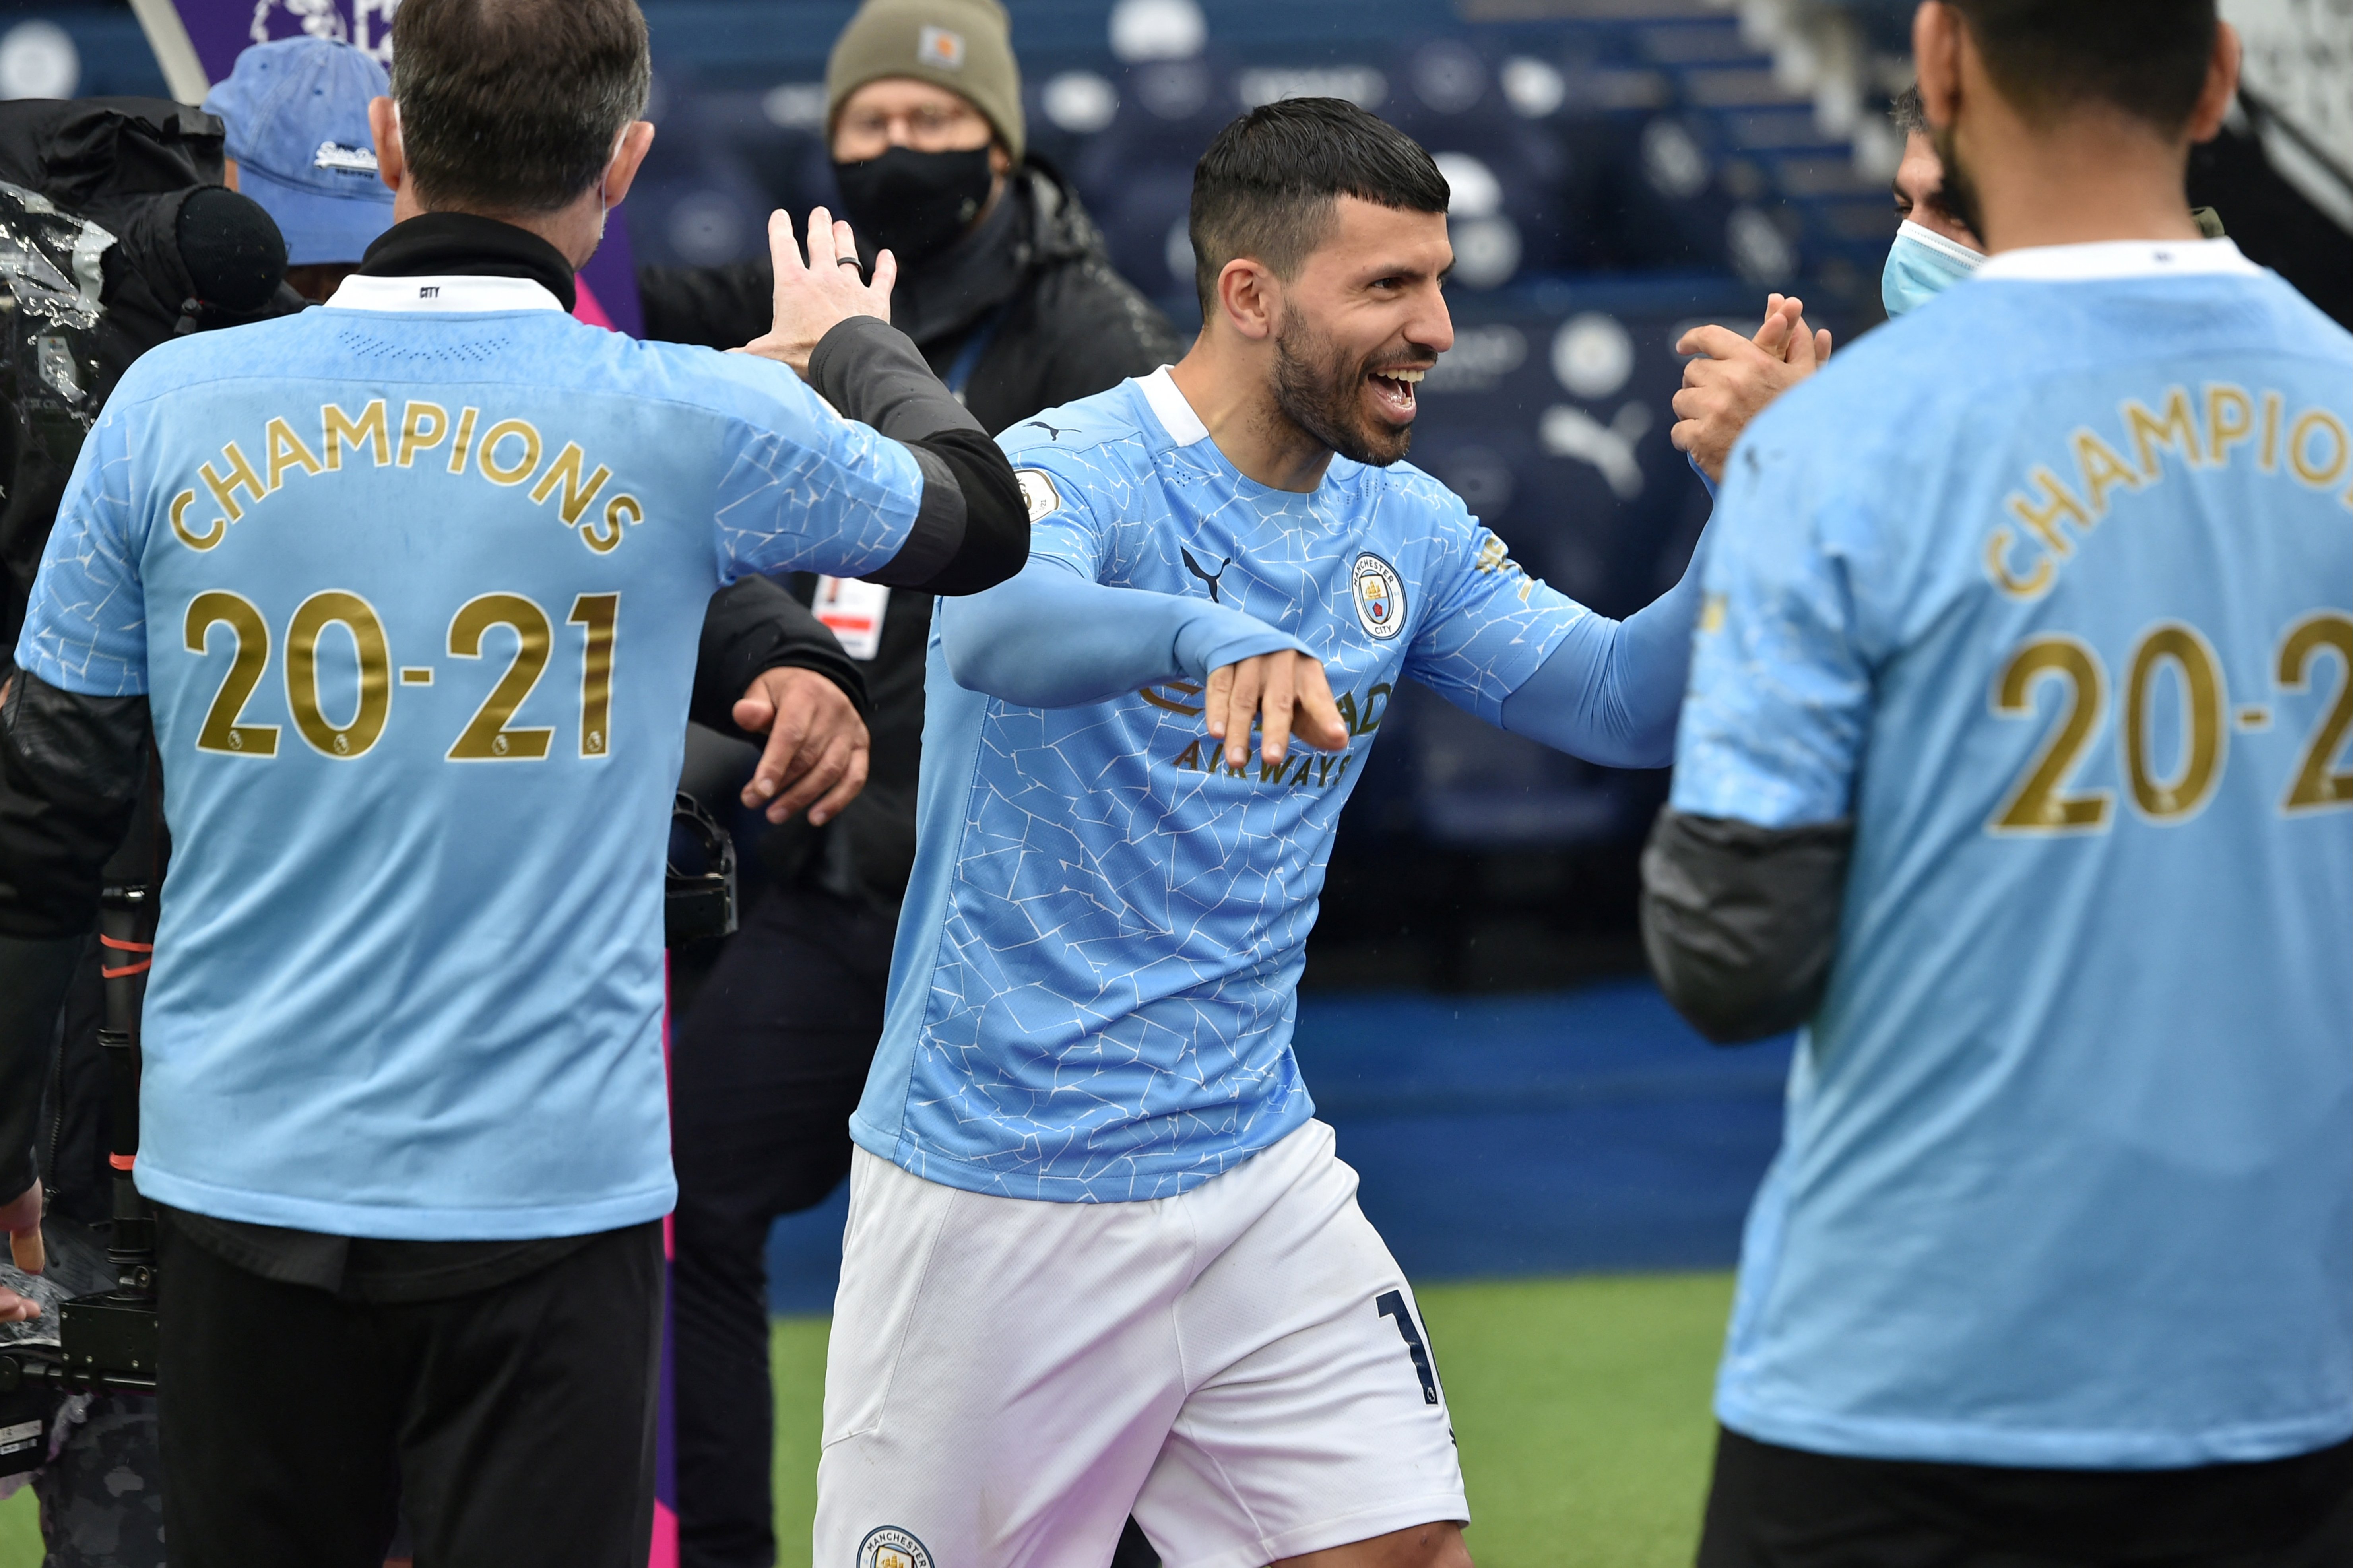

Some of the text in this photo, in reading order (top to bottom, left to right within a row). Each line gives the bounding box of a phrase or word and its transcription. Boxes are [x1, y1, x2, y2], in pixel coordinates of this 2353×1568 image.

[420, 286, 440, 299] CITY
[168, 398, 644, 555] CHAMPIONS
[1982, 382, 2353, 601] CHAMPIO
[1354, 559, 1394, 587] MANCHESTER
[1375, 625, 1392, 634] CITY
[183, 589, 621, 762] 20-21
[867, 1533, 927, 1568] MANCHESTER
